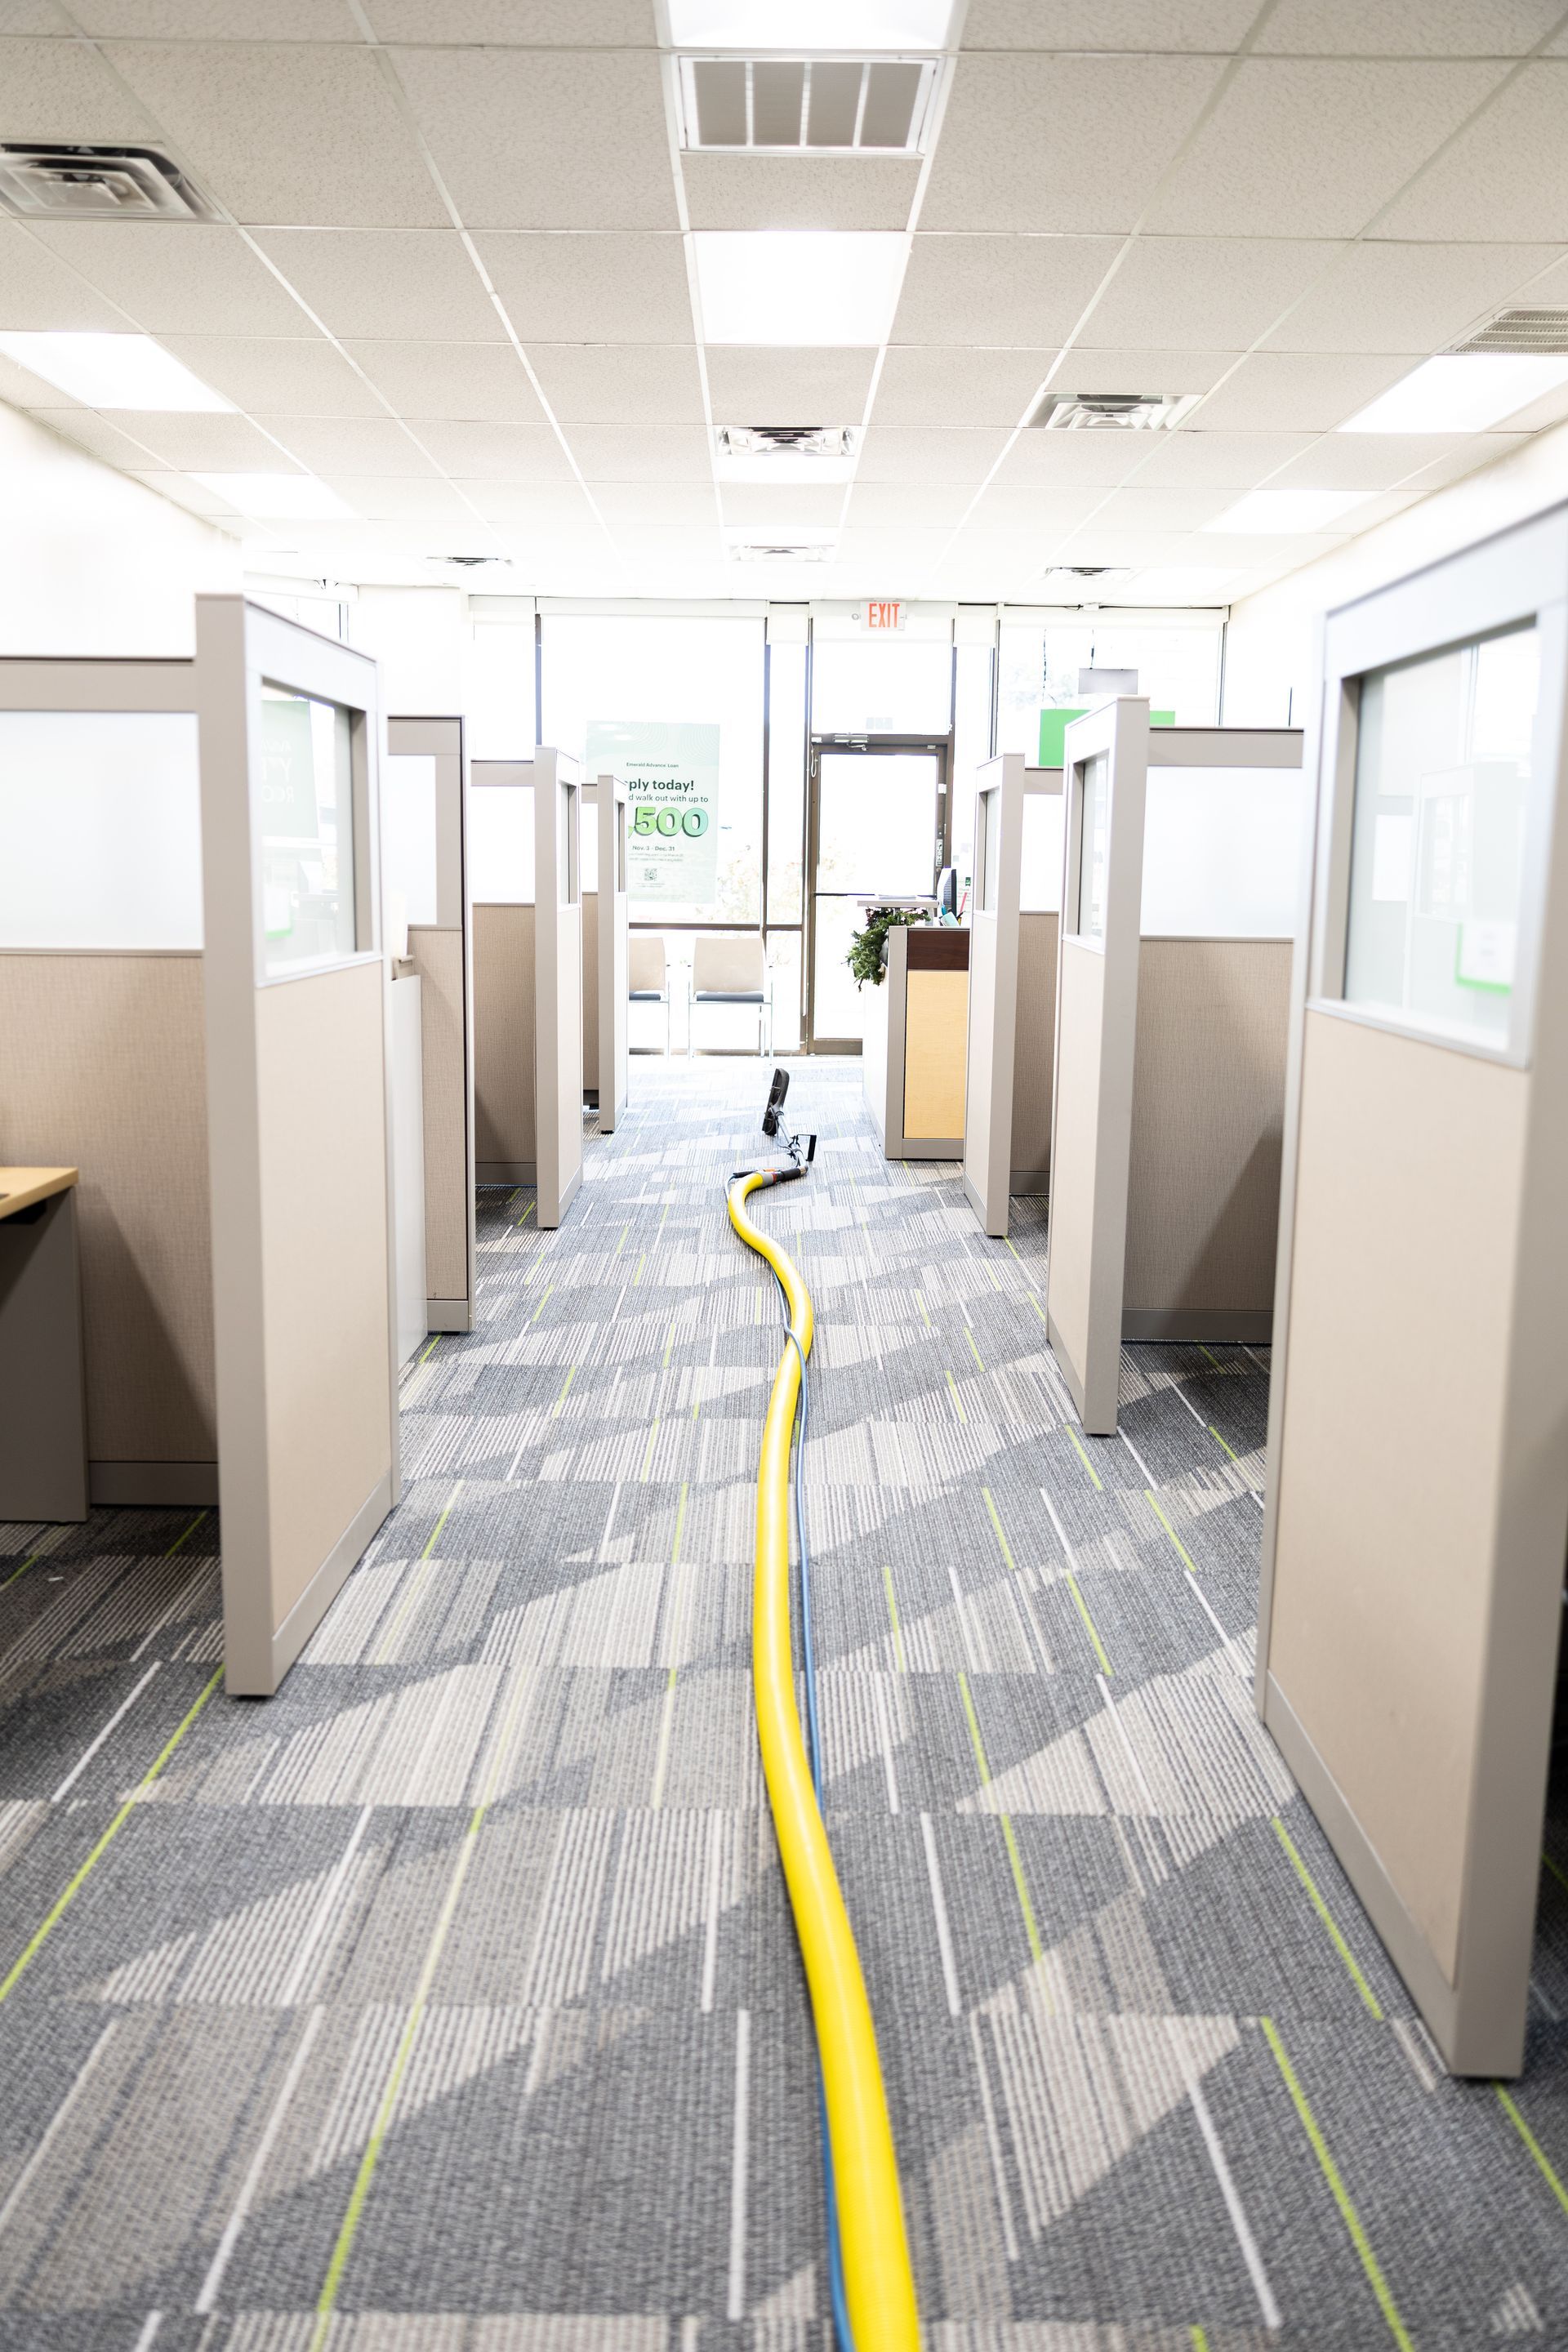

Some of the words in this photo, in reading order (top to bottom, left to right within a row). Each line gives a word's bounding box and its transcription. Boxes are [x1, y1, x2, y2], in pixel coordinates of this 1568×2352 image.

[869, 603, 900, 628] EXIT
[629, 778, 649, 791] ply
[653, 779, 694, 792] today!
[670, 795, 687, 803] with
[628, 806, 709, 838] ,500
